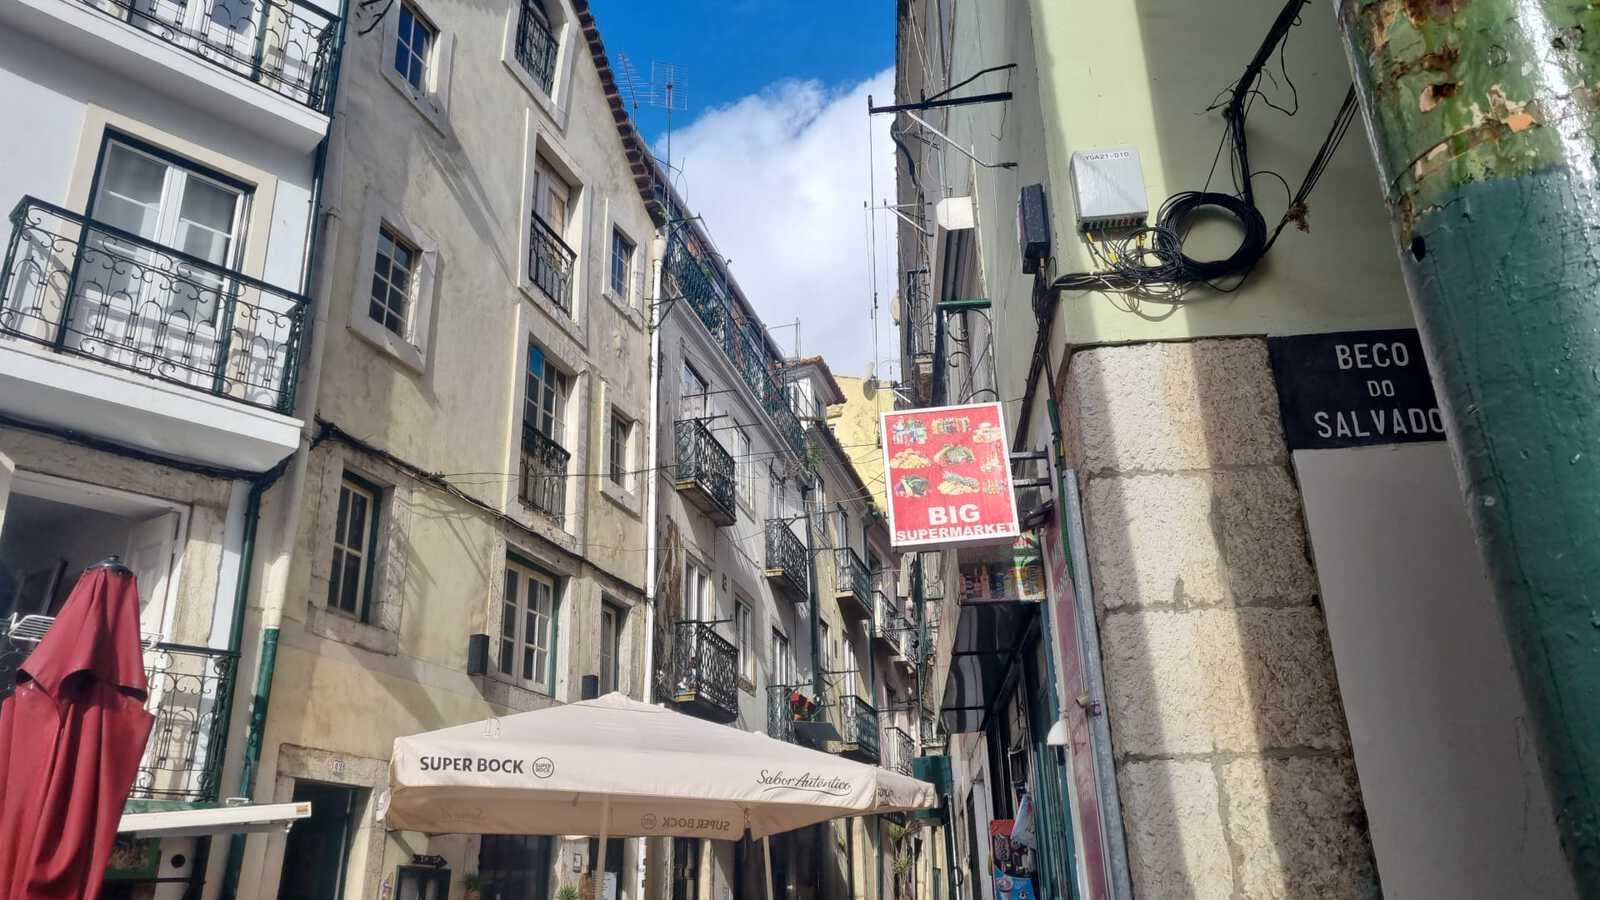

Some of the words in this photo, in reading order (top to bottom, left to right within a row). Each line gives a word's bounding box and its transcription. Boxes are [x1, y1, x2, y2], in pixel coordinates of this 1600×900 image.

[1335, 342, 1409, 370] BECO
[1367, 380, 1395, 397] DO
[1314, 408, 1447, 438] SALVADO
[928, 503, 981, 526] BIG
[896, 522, 1017, 541] SUPERMARKET
[419, 756, 473, 772] SUPER
[476, 758, 525, 774] BOCK
[757, 769, 795, 785] Sabor
